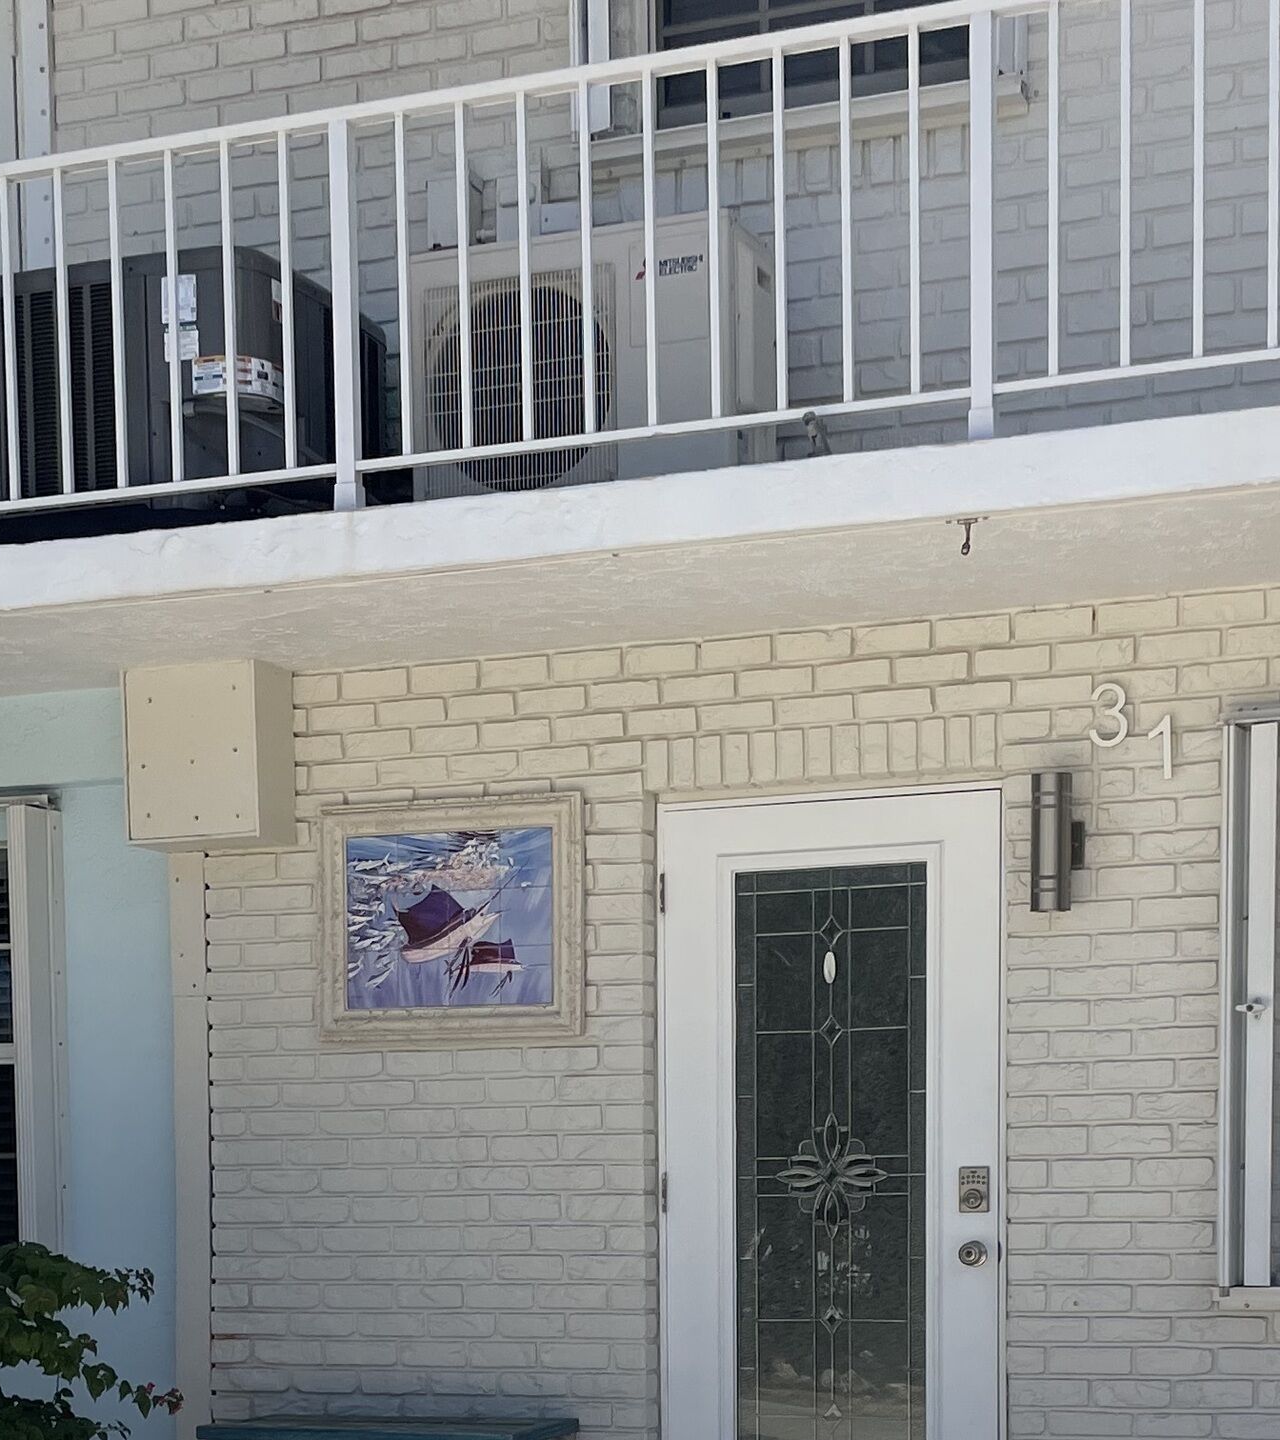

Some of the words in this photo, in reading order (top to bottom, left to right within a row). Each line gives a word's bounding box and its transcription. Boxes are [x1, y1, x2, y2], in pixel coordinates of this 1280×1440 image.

[658, 254, 704, 267] MITSUBISHI
[658, 264, 698, 277] ELECTRIC
[1089, 682, 1174, 780] 31
